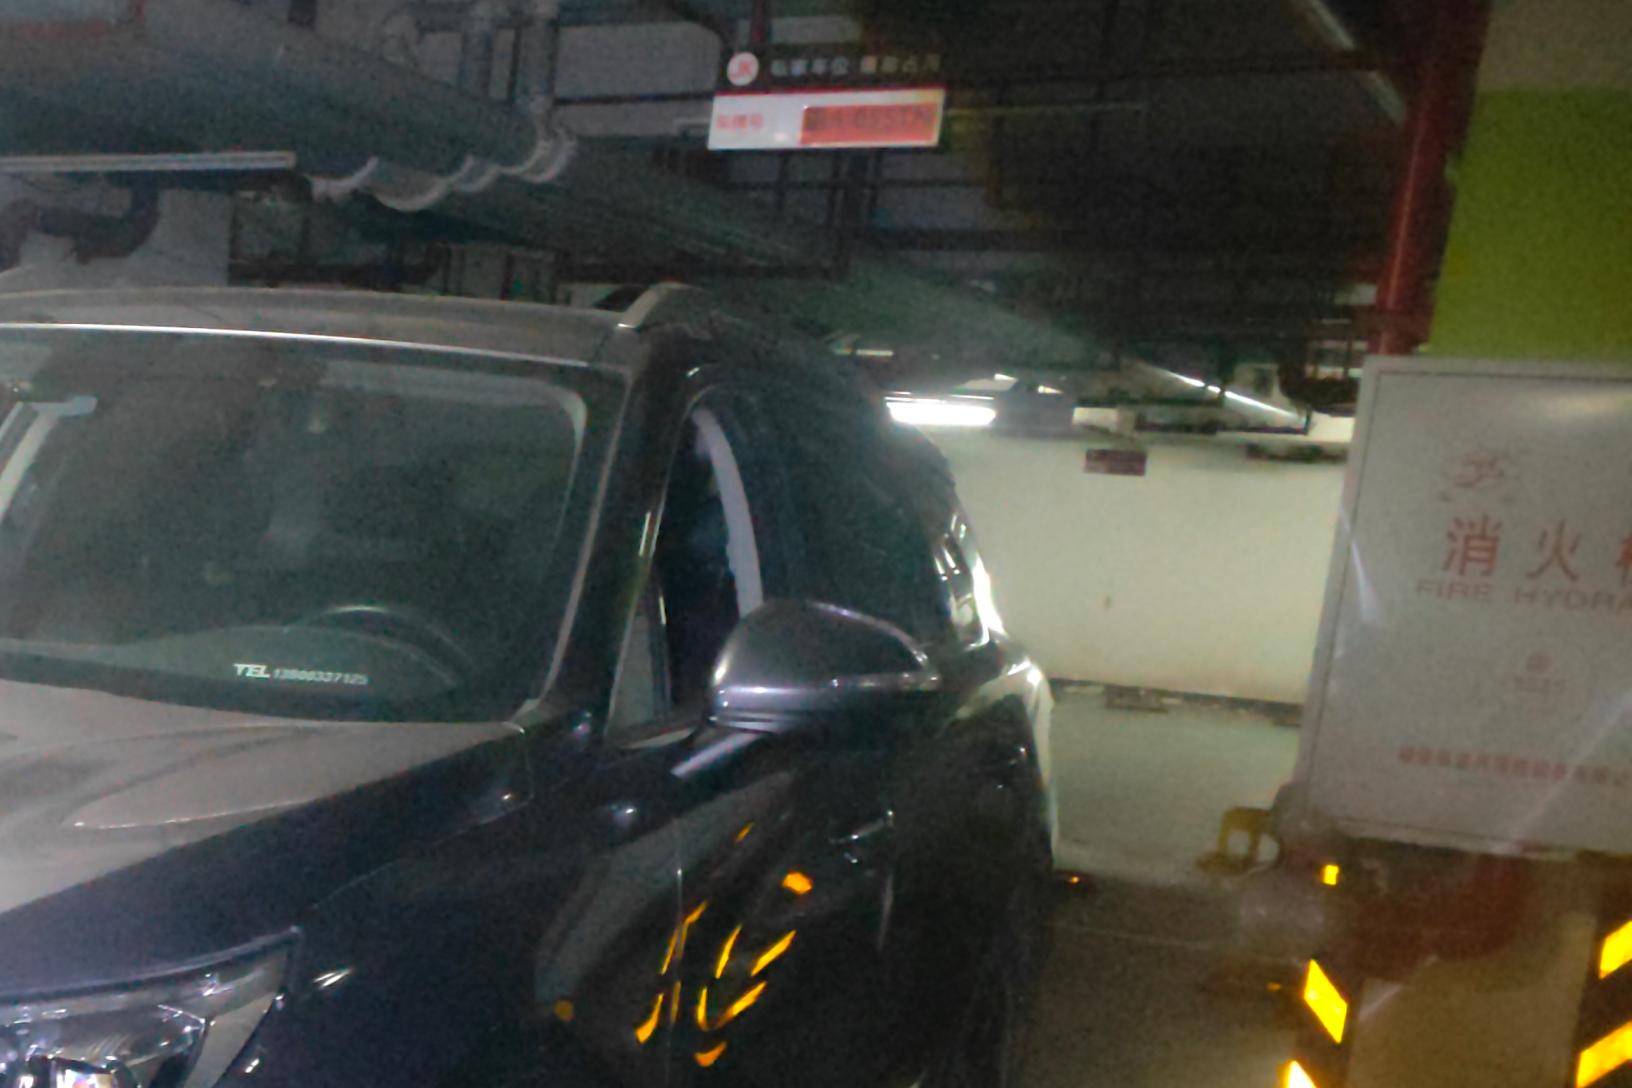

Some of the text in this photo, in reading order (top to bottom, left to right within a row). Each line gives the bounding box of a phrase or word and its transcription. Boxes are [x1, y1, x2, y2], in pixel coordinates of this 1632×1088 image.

[1442, 514, 1632, 585] 消火
[1416, 578, 1493, 602] FIRE
[233, 663, 270, 679] TEL
